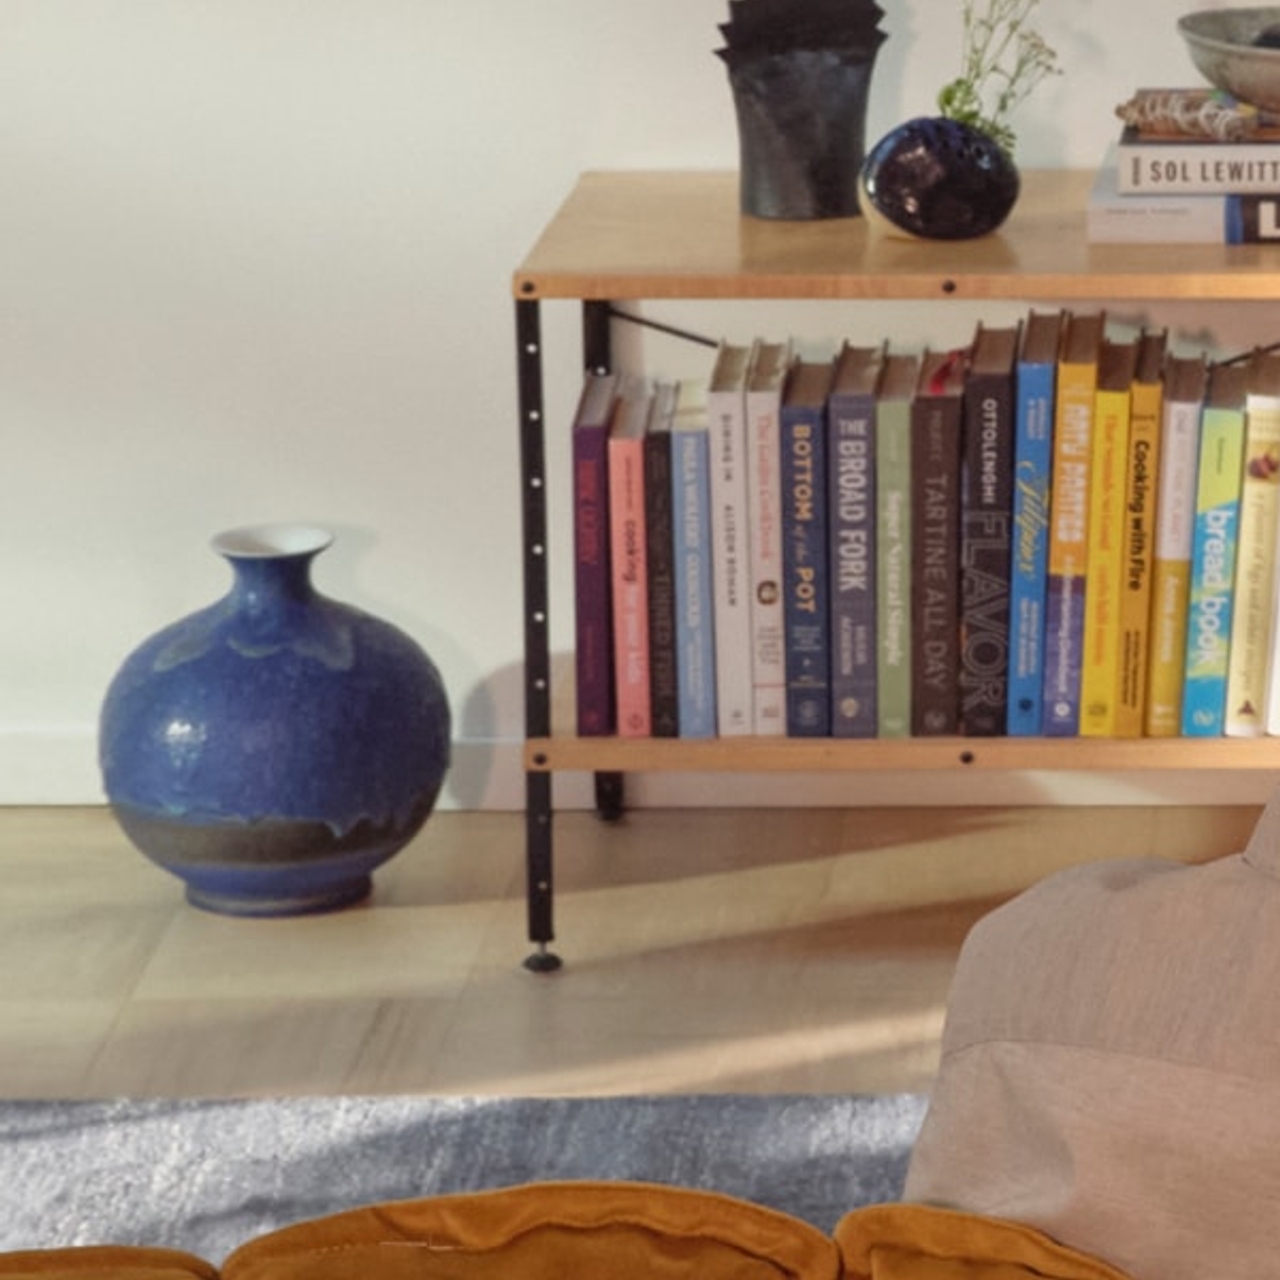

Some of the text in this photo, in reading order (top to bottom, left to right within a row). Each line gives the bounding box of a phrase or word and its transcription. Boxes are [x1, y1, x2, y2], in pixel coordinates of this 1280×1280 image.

[1149, 160, 1191, 184] SOL
[1200, 160, 1280, 183] LEWITT
[721, 413, 738, 607] DINING IN ALISON ROMAN
[792, 423, 814, 520] BOTTOM
[838, 419, 868, 592] THE BROAD FORK
[1128, 439, 1150, 512] Cooking
[623, 519, 641, 582] cooking
[961, 397, 1009, 710] OTTOLENGHI FLAVOR
[1128, 557, 1145, 591] Fire
[1129, 516, 1147, 555] with
[795, 566, 816, 613] POT
[923, 473, 948, 689] TARTINE ALL DAY
[1196, 509, 1233, 664] bread book
